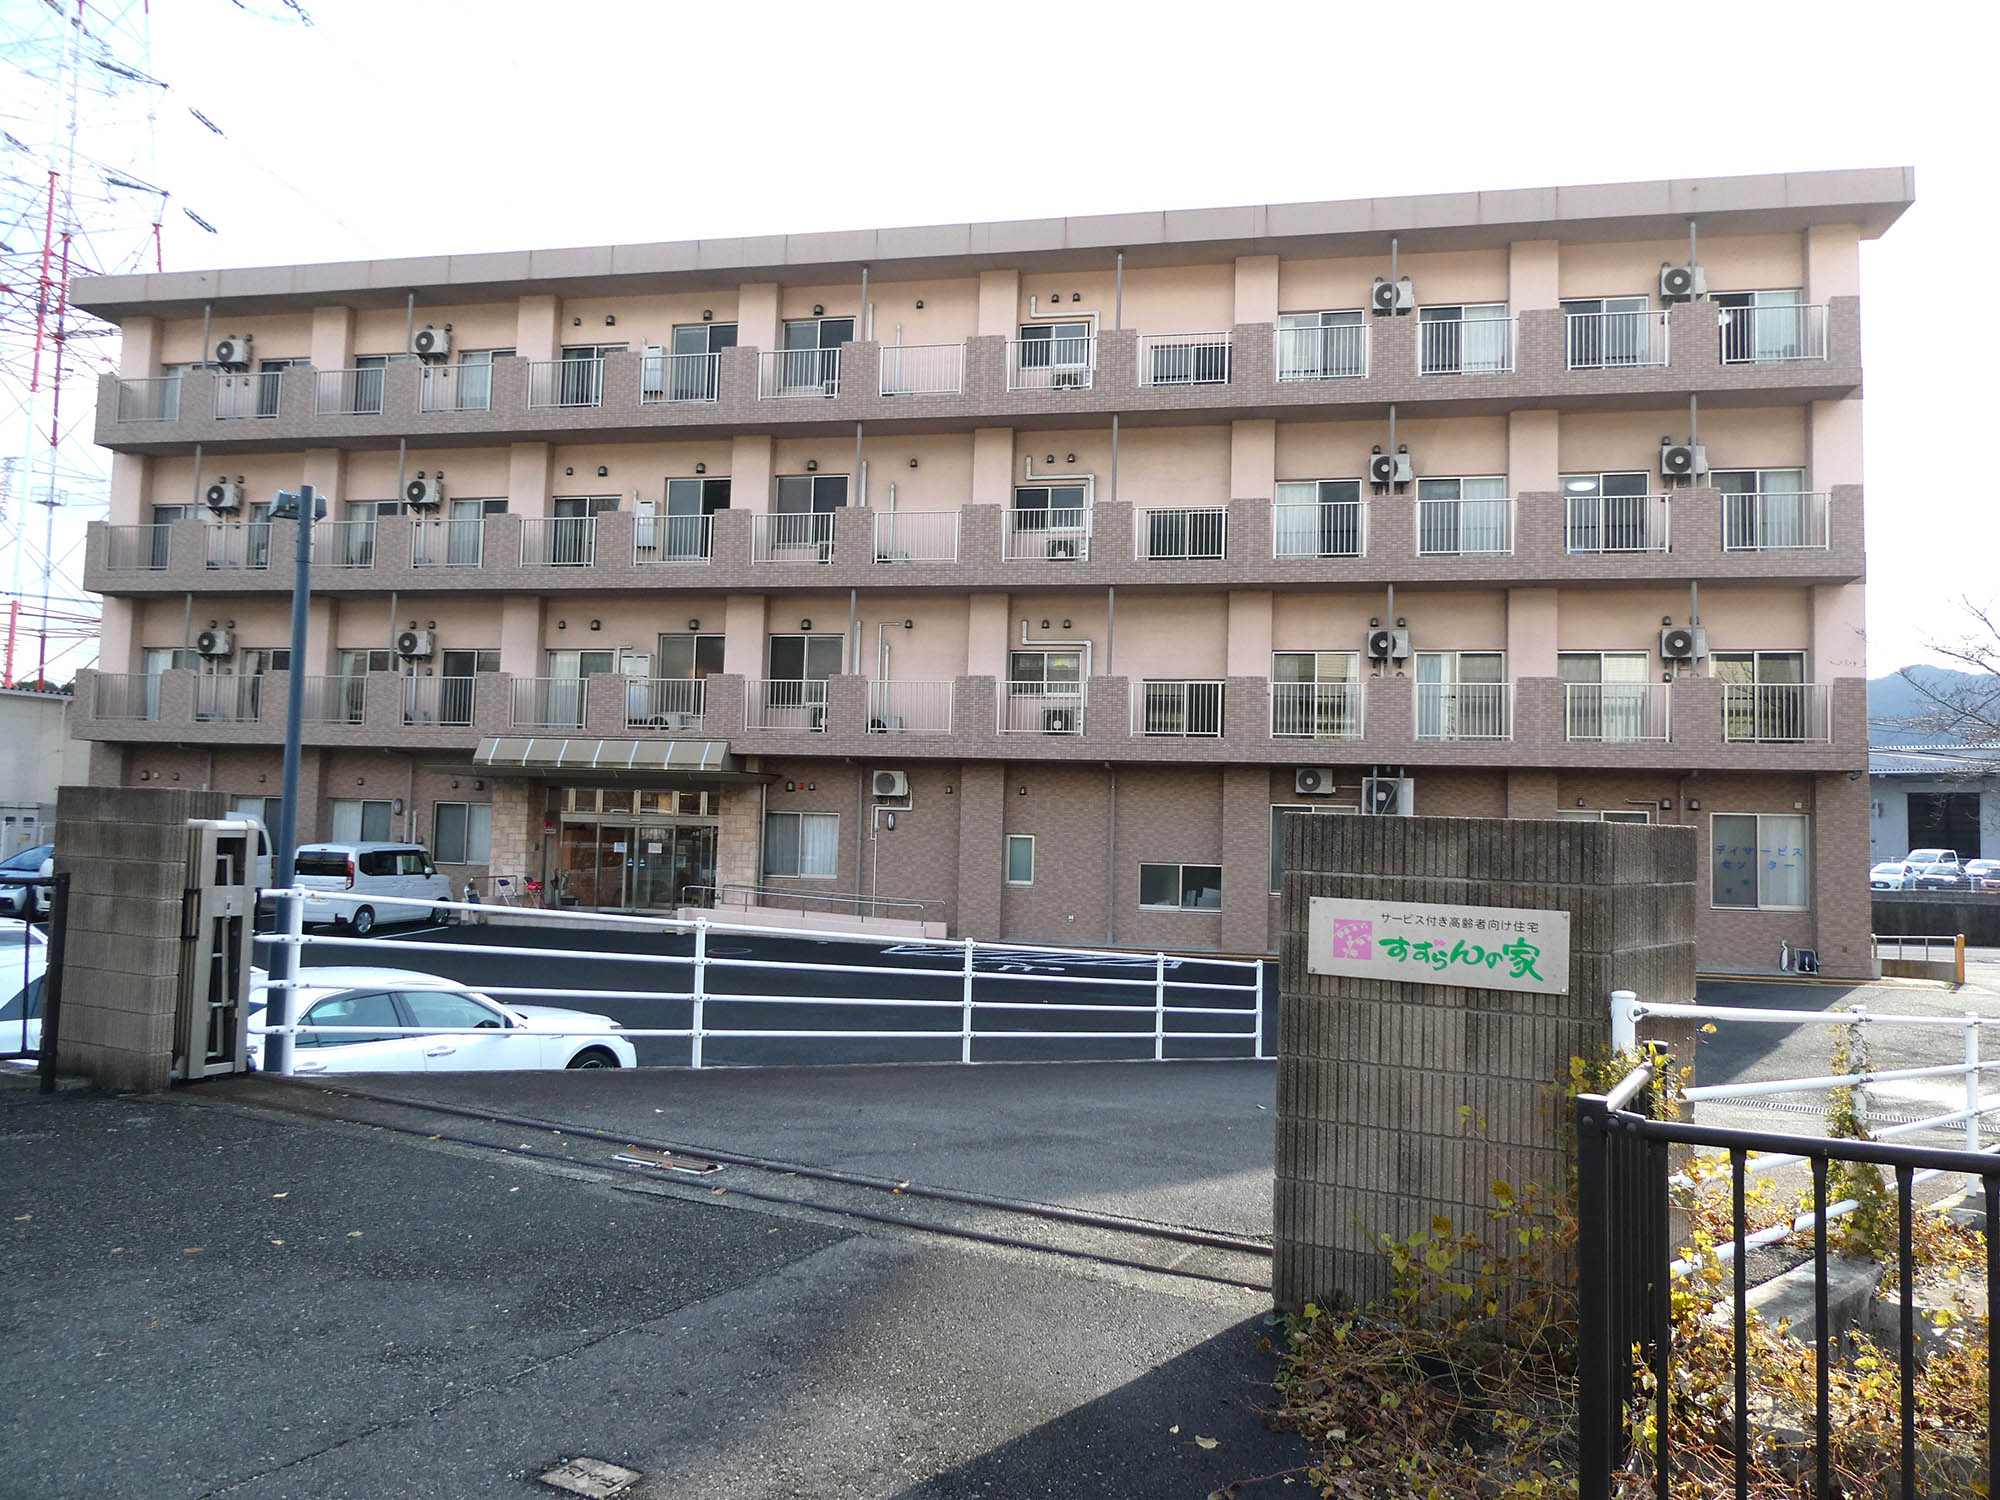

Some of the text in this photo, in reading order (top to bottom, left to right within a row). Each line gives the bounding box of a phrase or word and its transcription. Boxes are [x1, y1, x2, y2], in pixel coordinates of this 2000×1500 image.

[1380, 912, 1539, 934] サービス付き高齢者向け住宅
[1378, 936, 1544, 982] すずらんの家
